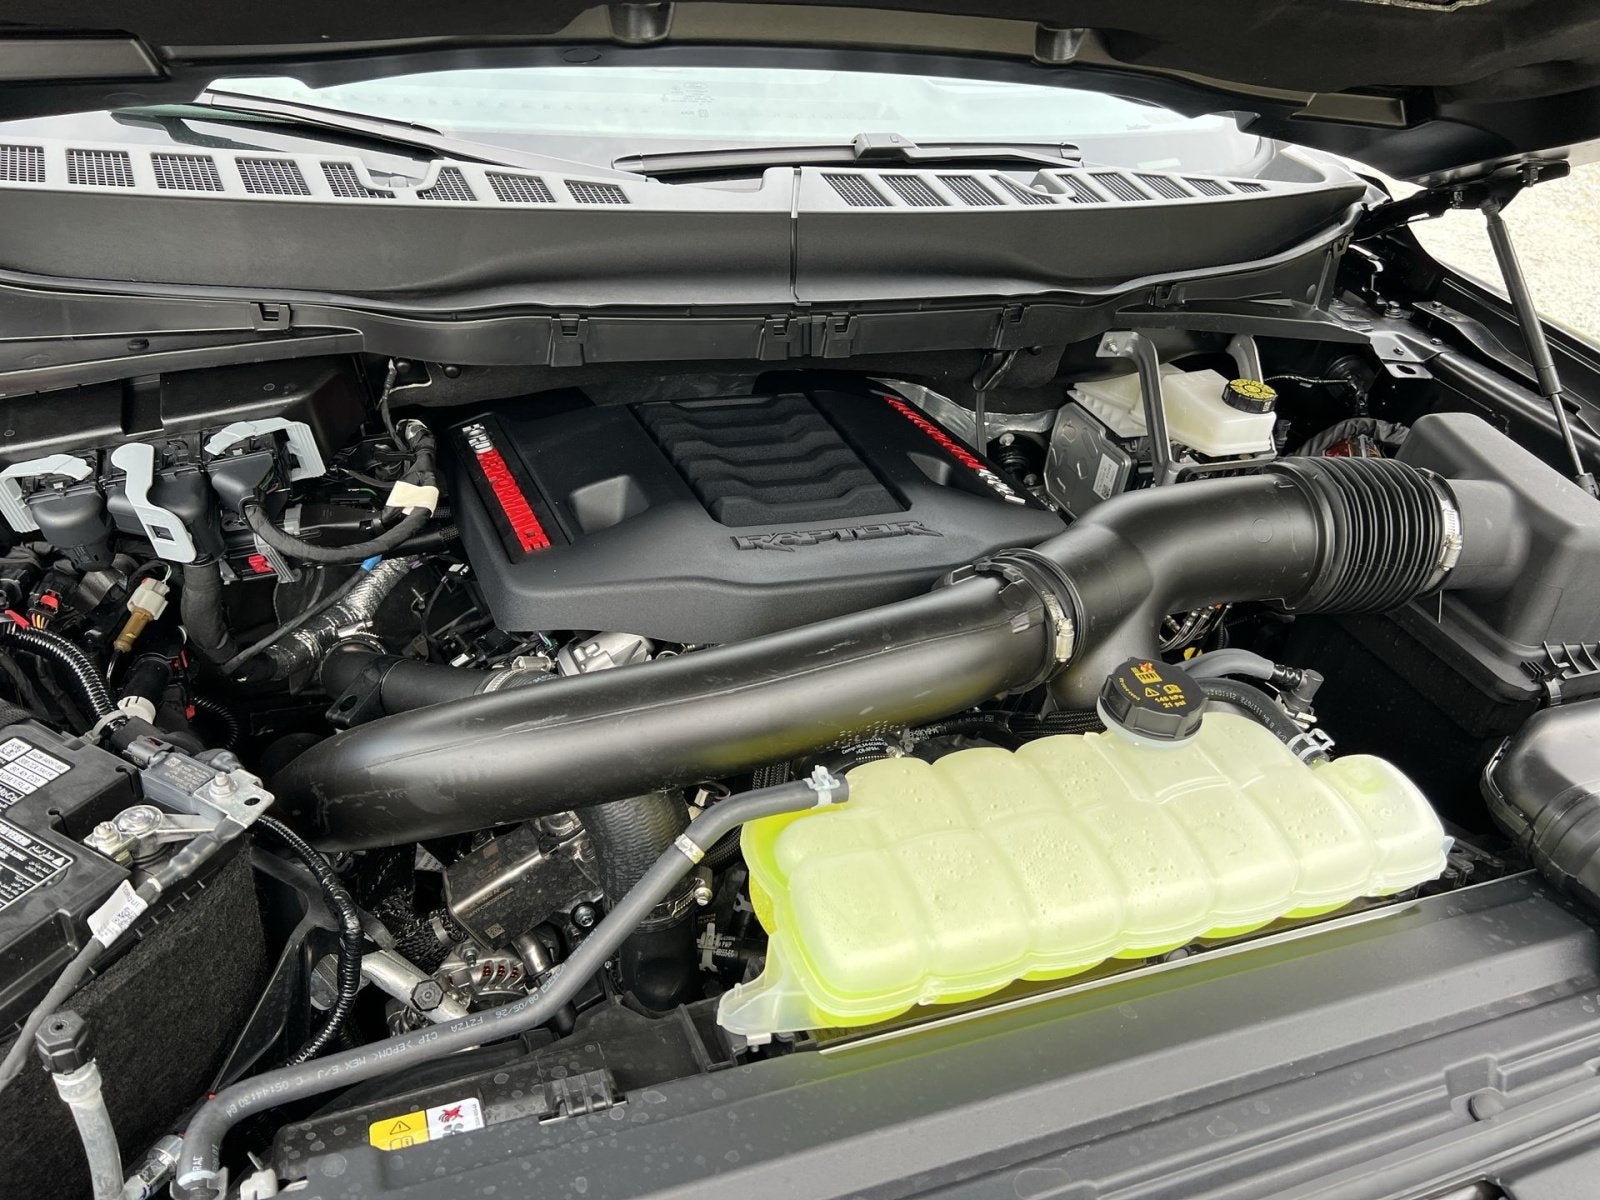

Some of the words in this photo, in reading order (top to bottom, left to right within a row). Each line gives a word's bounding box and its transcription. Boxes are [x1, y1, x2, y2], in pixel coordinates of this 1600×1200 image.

[462, 423, 494, 454] FORD
[476, 447, 552, 553] PERFORMANCE
[730, 520, 944, 553] RAPTOR
[1175, 700, 1187, 708] psi
[418, 1031, 438, 1045] CIP
[345, 1056, 366, 1070] MEX
